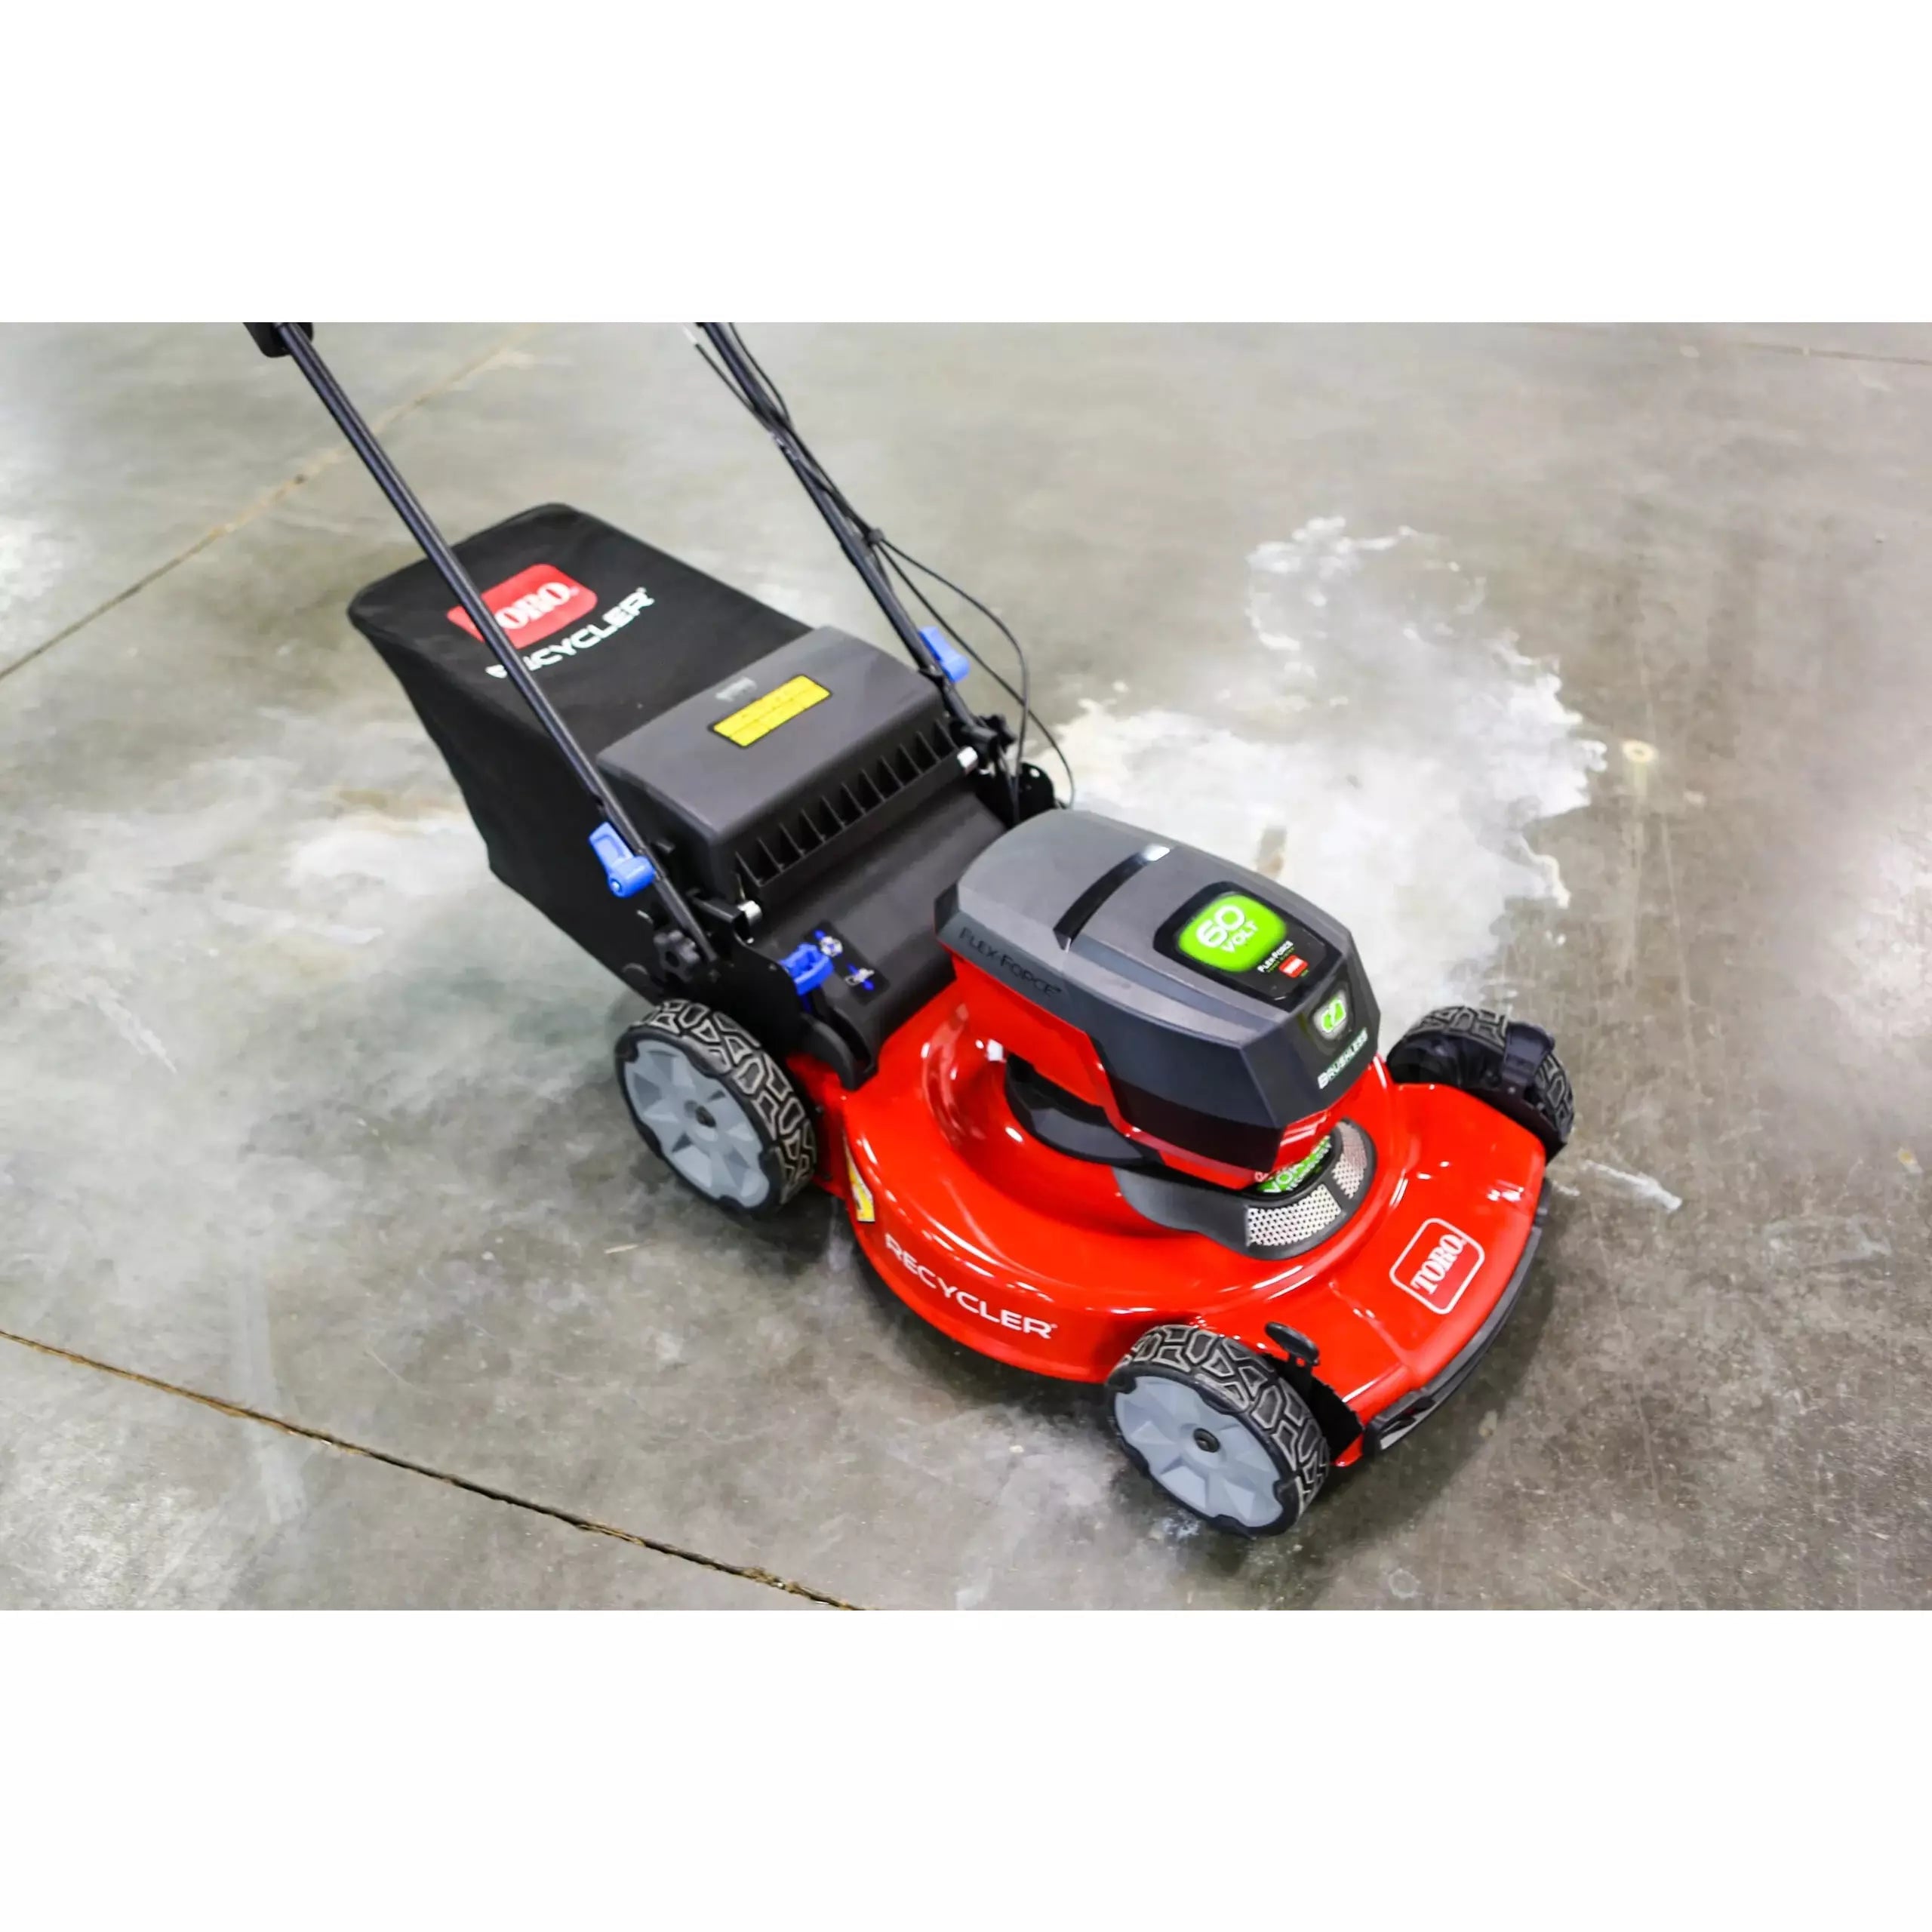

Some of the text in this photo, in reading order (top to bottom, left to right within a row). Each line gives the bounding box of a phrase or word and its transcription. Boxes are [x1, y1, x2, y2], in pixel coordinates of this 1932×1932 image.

[494, 582, 571, 629] ORO
[1195, 904, 1245, 948] 60
[1222, 919, 1258, 953] VOLT
[1318, 1027, 1368, 1089] BRUSHLESS
[884, 1232, 1052, 1340] RECYCLER
[1410, 1234, 1465, 1294] TORO
